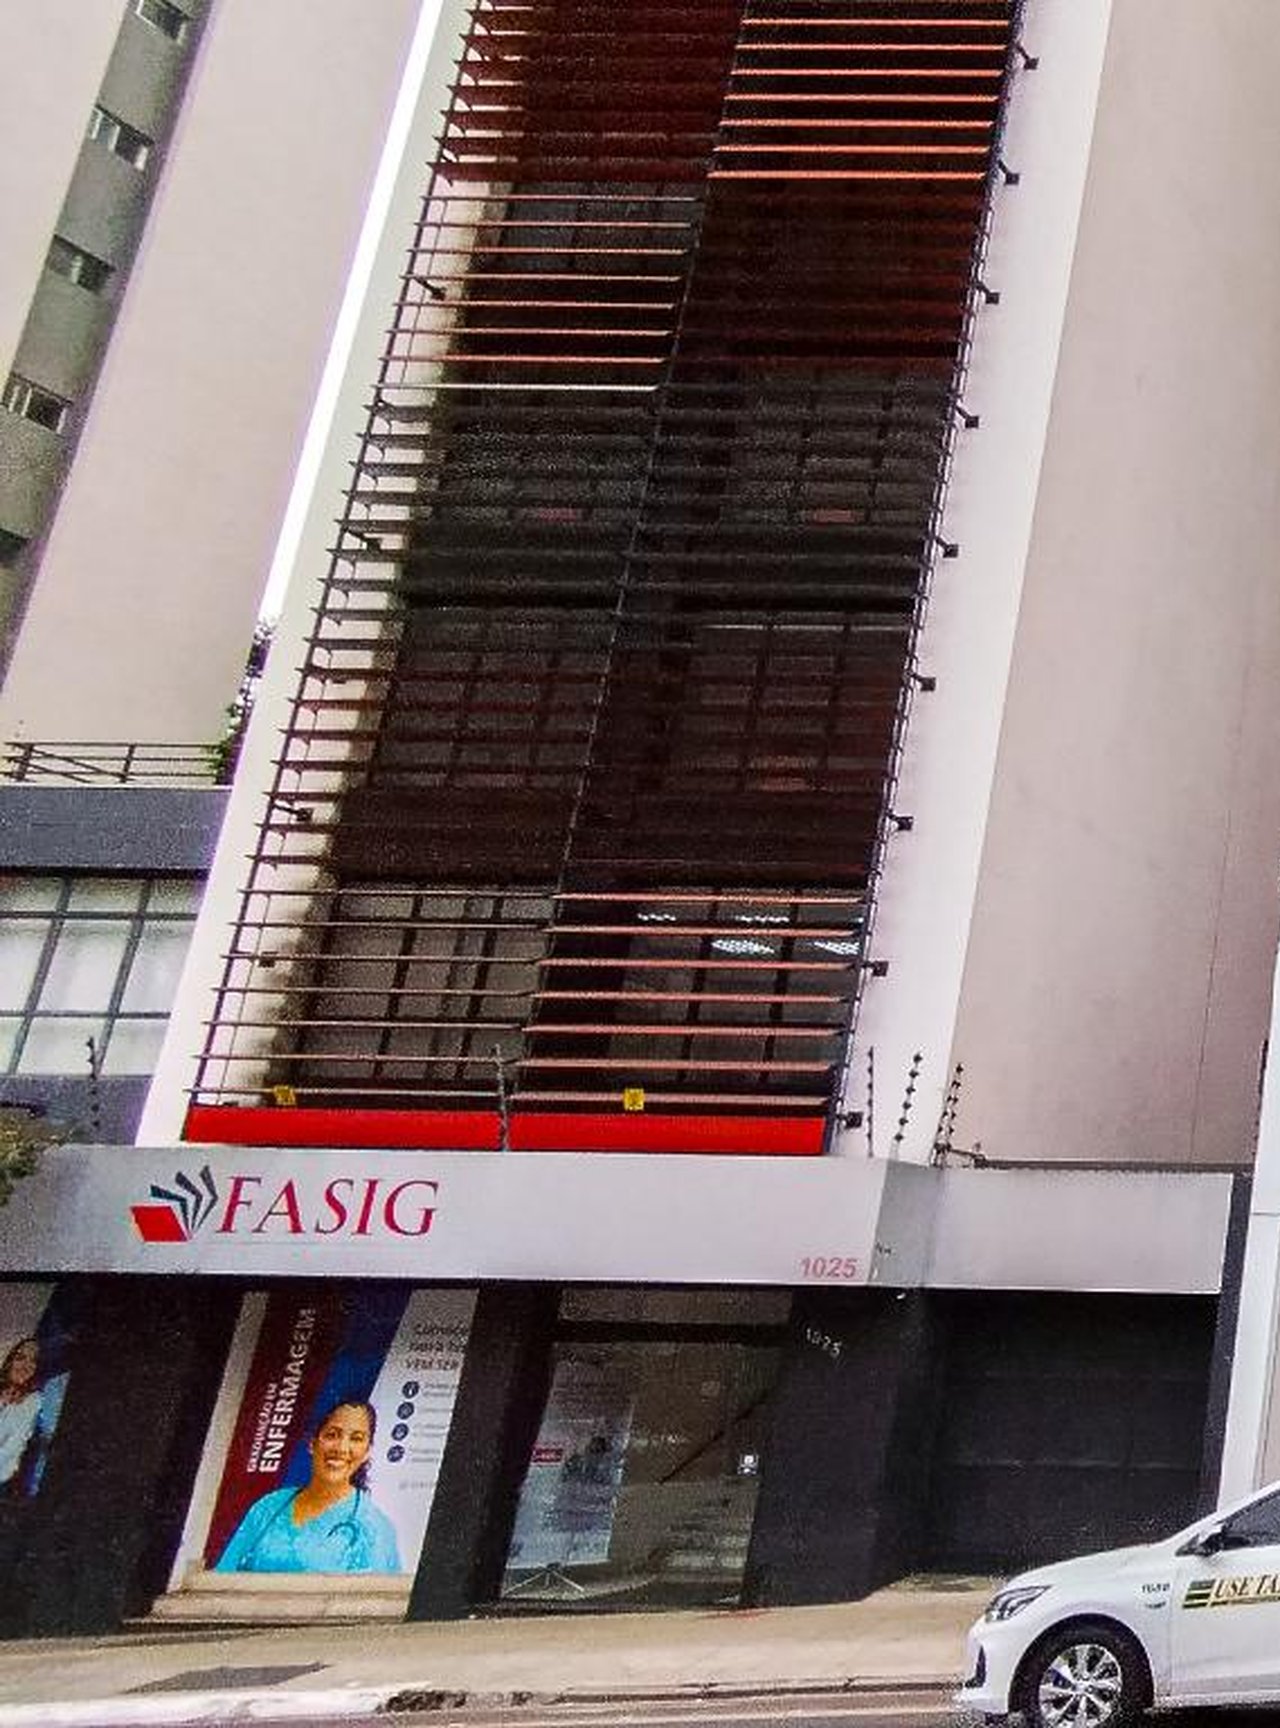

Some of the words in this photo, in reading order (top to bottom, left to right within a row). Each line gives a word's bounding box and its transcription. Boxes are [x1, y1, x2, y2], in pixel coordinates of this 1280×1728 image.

[215, 1175, 439, 1237] FASIG
[800, 1257, 858, 1279] 1025
[258, 1307, 317, 1474] ENFERMAGEM
[1213, 1577, 1251, 1599] USE
